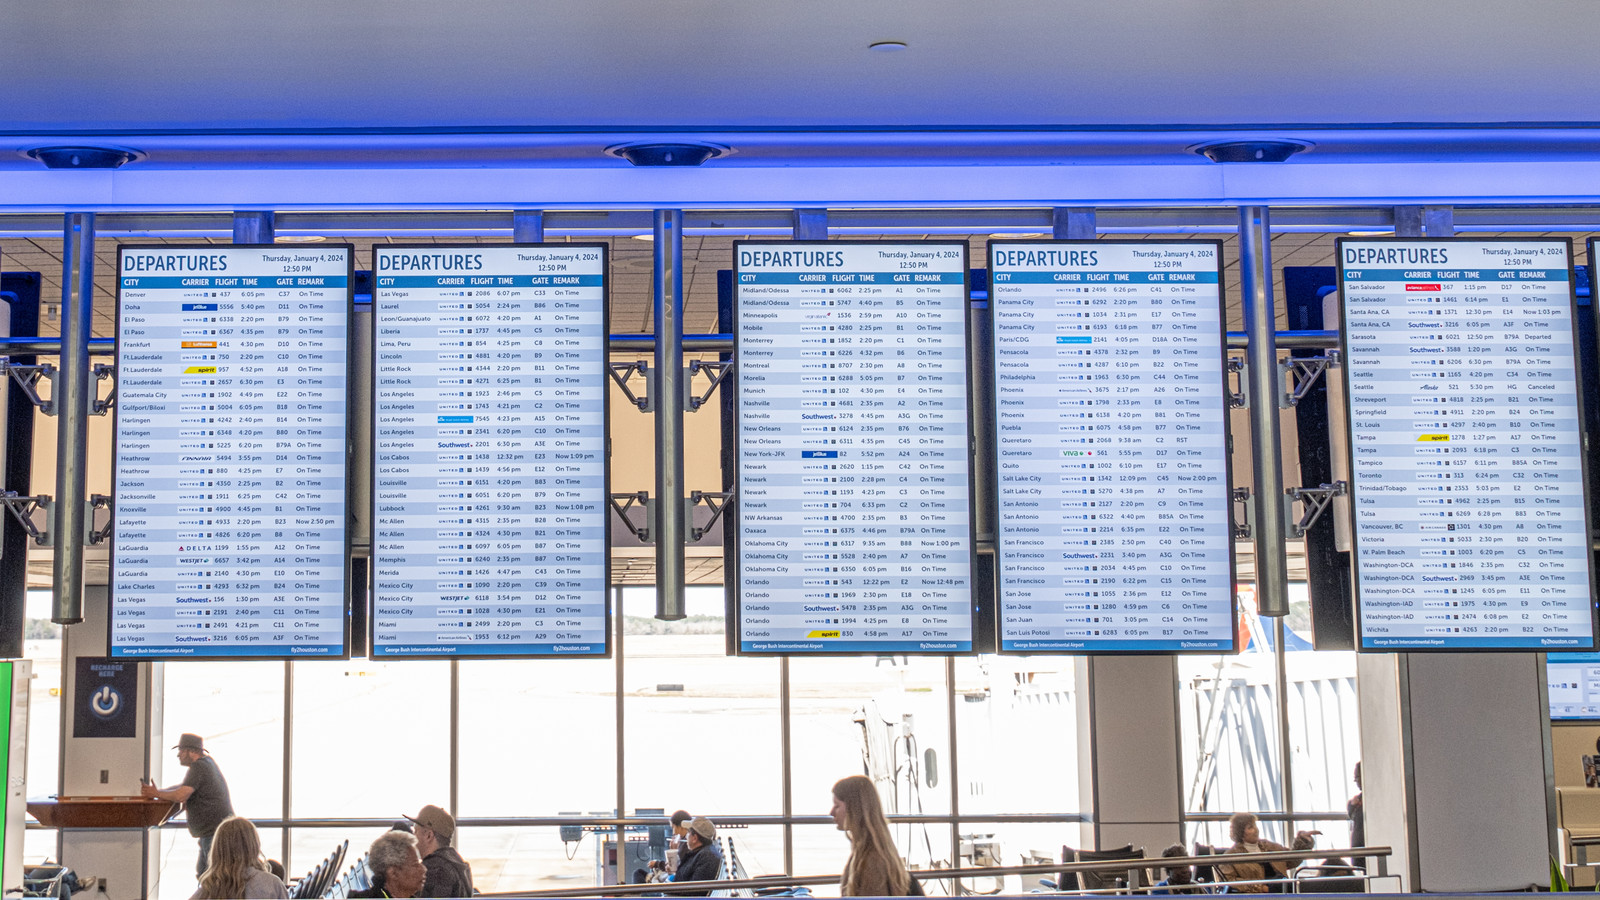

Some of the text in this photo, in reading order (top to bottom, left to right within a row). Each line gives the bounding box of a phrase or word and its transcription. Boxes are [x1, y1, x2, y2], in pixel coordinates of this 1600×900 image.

[878, 250, 910, 260] Thursday,
[909, 250, 935, 260] January
[943, 251, 960, 259] 2024
[1132, 250, 1164, 259] Thursday,
[1163, 250, 1189, 259] January
[1197, 250, 1214, 258] 2024
[1346, 248, 1448, 264] DEPARTURES
[1481, 247, 1513, 257] Thursday,
[1513, 248, 1539, 257] January
[262, 254, 294, 264] Thursday,
[293, 254, 320, 264] January
[327, 254, 344, 262] 2024
[380, 254, 483, 271] DEPARTURES
[517, 253, 549, 263] Thursday,
[548, 253, 574, 262] January
[582, 253, 599, 261] 2024
[741, 251, 844, 267] DEPARTURES
[996, 250, 1098, 267] DEPARTURES
[1503, 258, 1521, 266] 12:50
[124, 255, 227, 272] DEPARTURES
[538, 264, 556, 272] 12:50
[899, 261, 928, 269] 12:50 PM
[1153, 260, 1182, 268] 12:50 PM
[283, 265, 301, 273] 12:50
[741, 274, 941, 282] CITY CARRIER FLIGHT TIME GATE REMARK
[996, 273, 1196, 281] CITY CARRIER FLIGHT TIME GATE REMARK
[1346, 271, 1546, 279] CITY CARRIER FLIGHT TIME GATE REMARK
[123, 277, 324, 286] CITY CARRIER FLIGHT TIME GATE REMARK
[379, 276, 580, 286] CITY CARRIER FLIGHT TIME GATE REMARK
[390, 441, 415, 449] Angeles
[437, 441, 470, 449] Southwest
[1363, 574, 1415, 583] Washington-DCA
[919, 642, 957, 650] fly2houston.com
[1180, 641, 1219, 649] fly2houston.com
[1541, 638, 1579, 646] fly2houston.com
